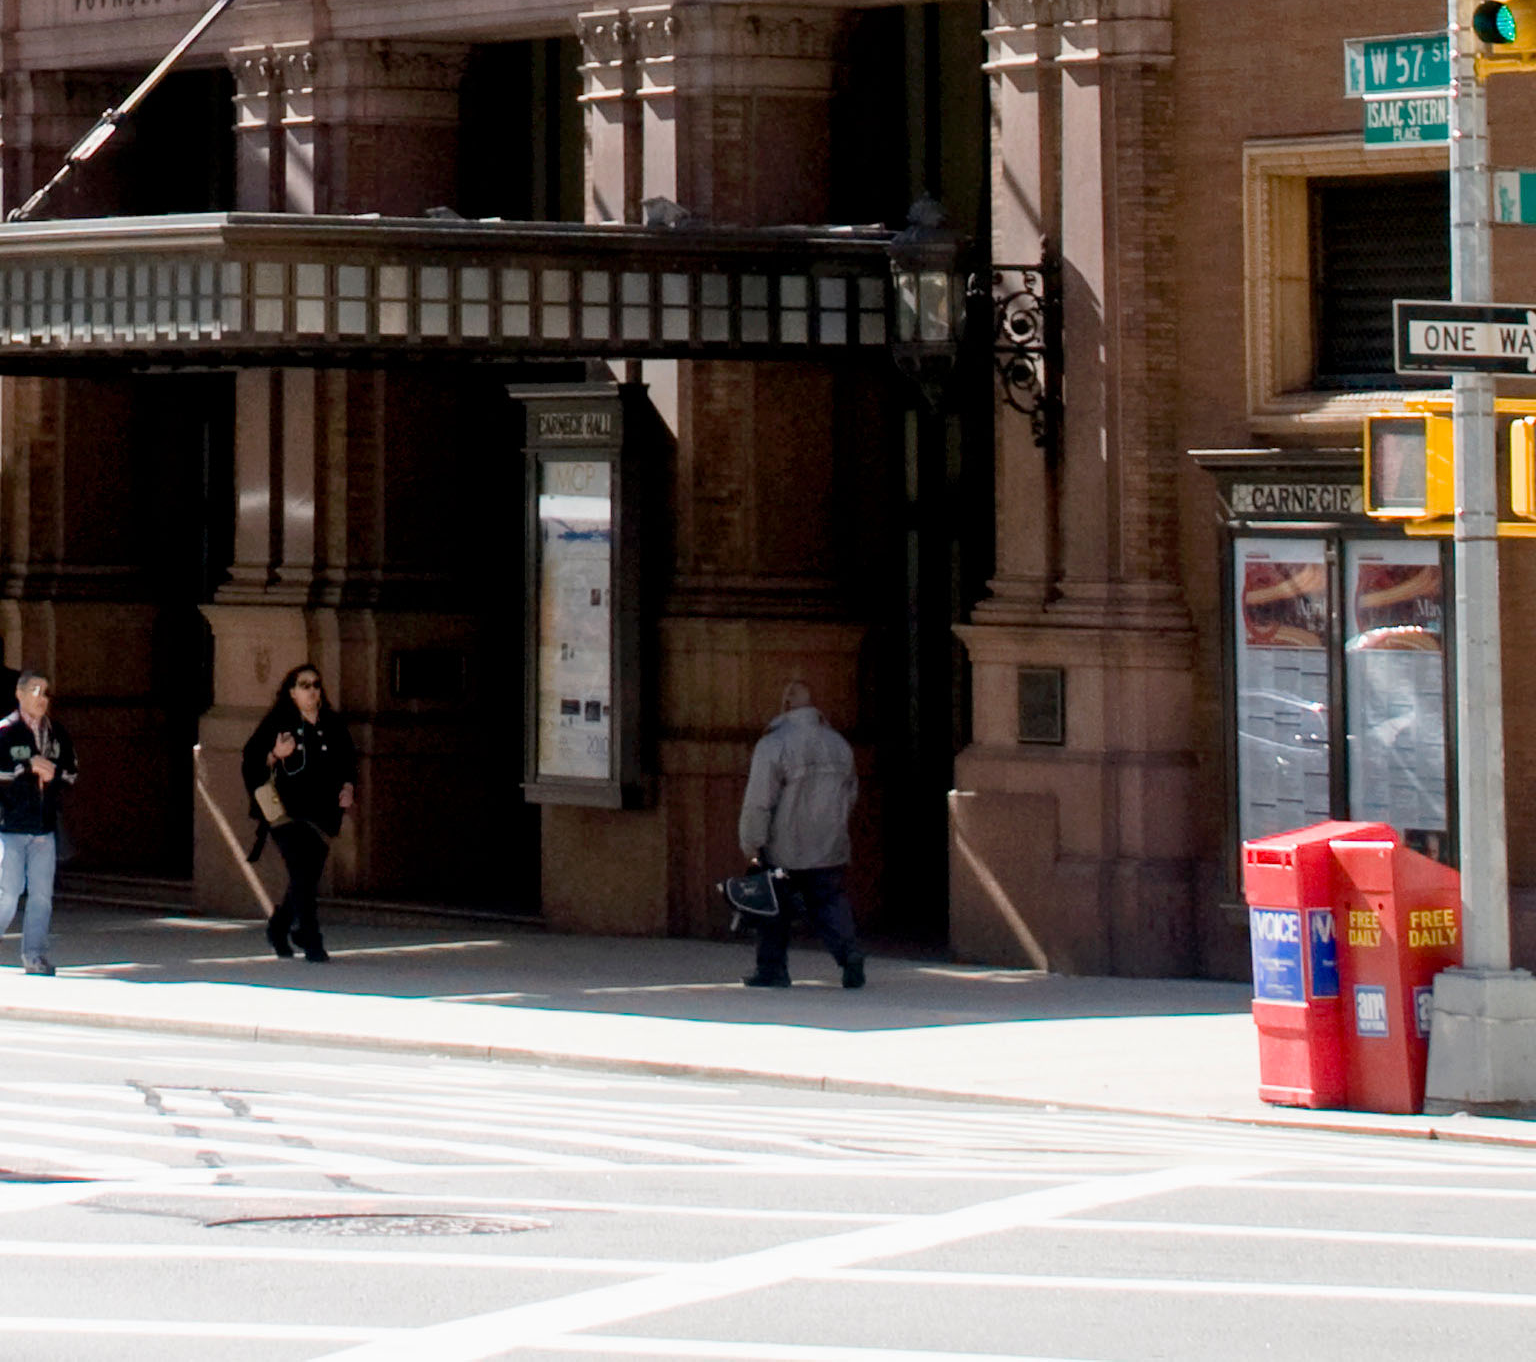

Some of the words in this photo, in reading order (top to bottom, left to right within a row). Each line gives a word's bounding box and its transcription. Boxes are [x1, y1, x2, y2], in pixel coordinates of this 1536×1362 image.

[1371, 47, 1387, 85] W
[1396, 44, 1424, 84] 57
[1432, 45, 1449, 62] ST
[1367, 101, 1404, 128] ISAAC
[1408, 99, 1446, 125] STERN
[1393, 127, 1421, 141] PLACE
[1424, 325, 1476, 351] ONE
[1252, 487, 1351, 511] CARNEGIE
[1255, 911, 1299, 943] VOICE
[1349, 910, 1379, 927] FREE
[1410, 909, 1455, 927] FREE
[1348, 929, 1382, 947] DAILY
[1409, 928, 1457, 948] DAILY
